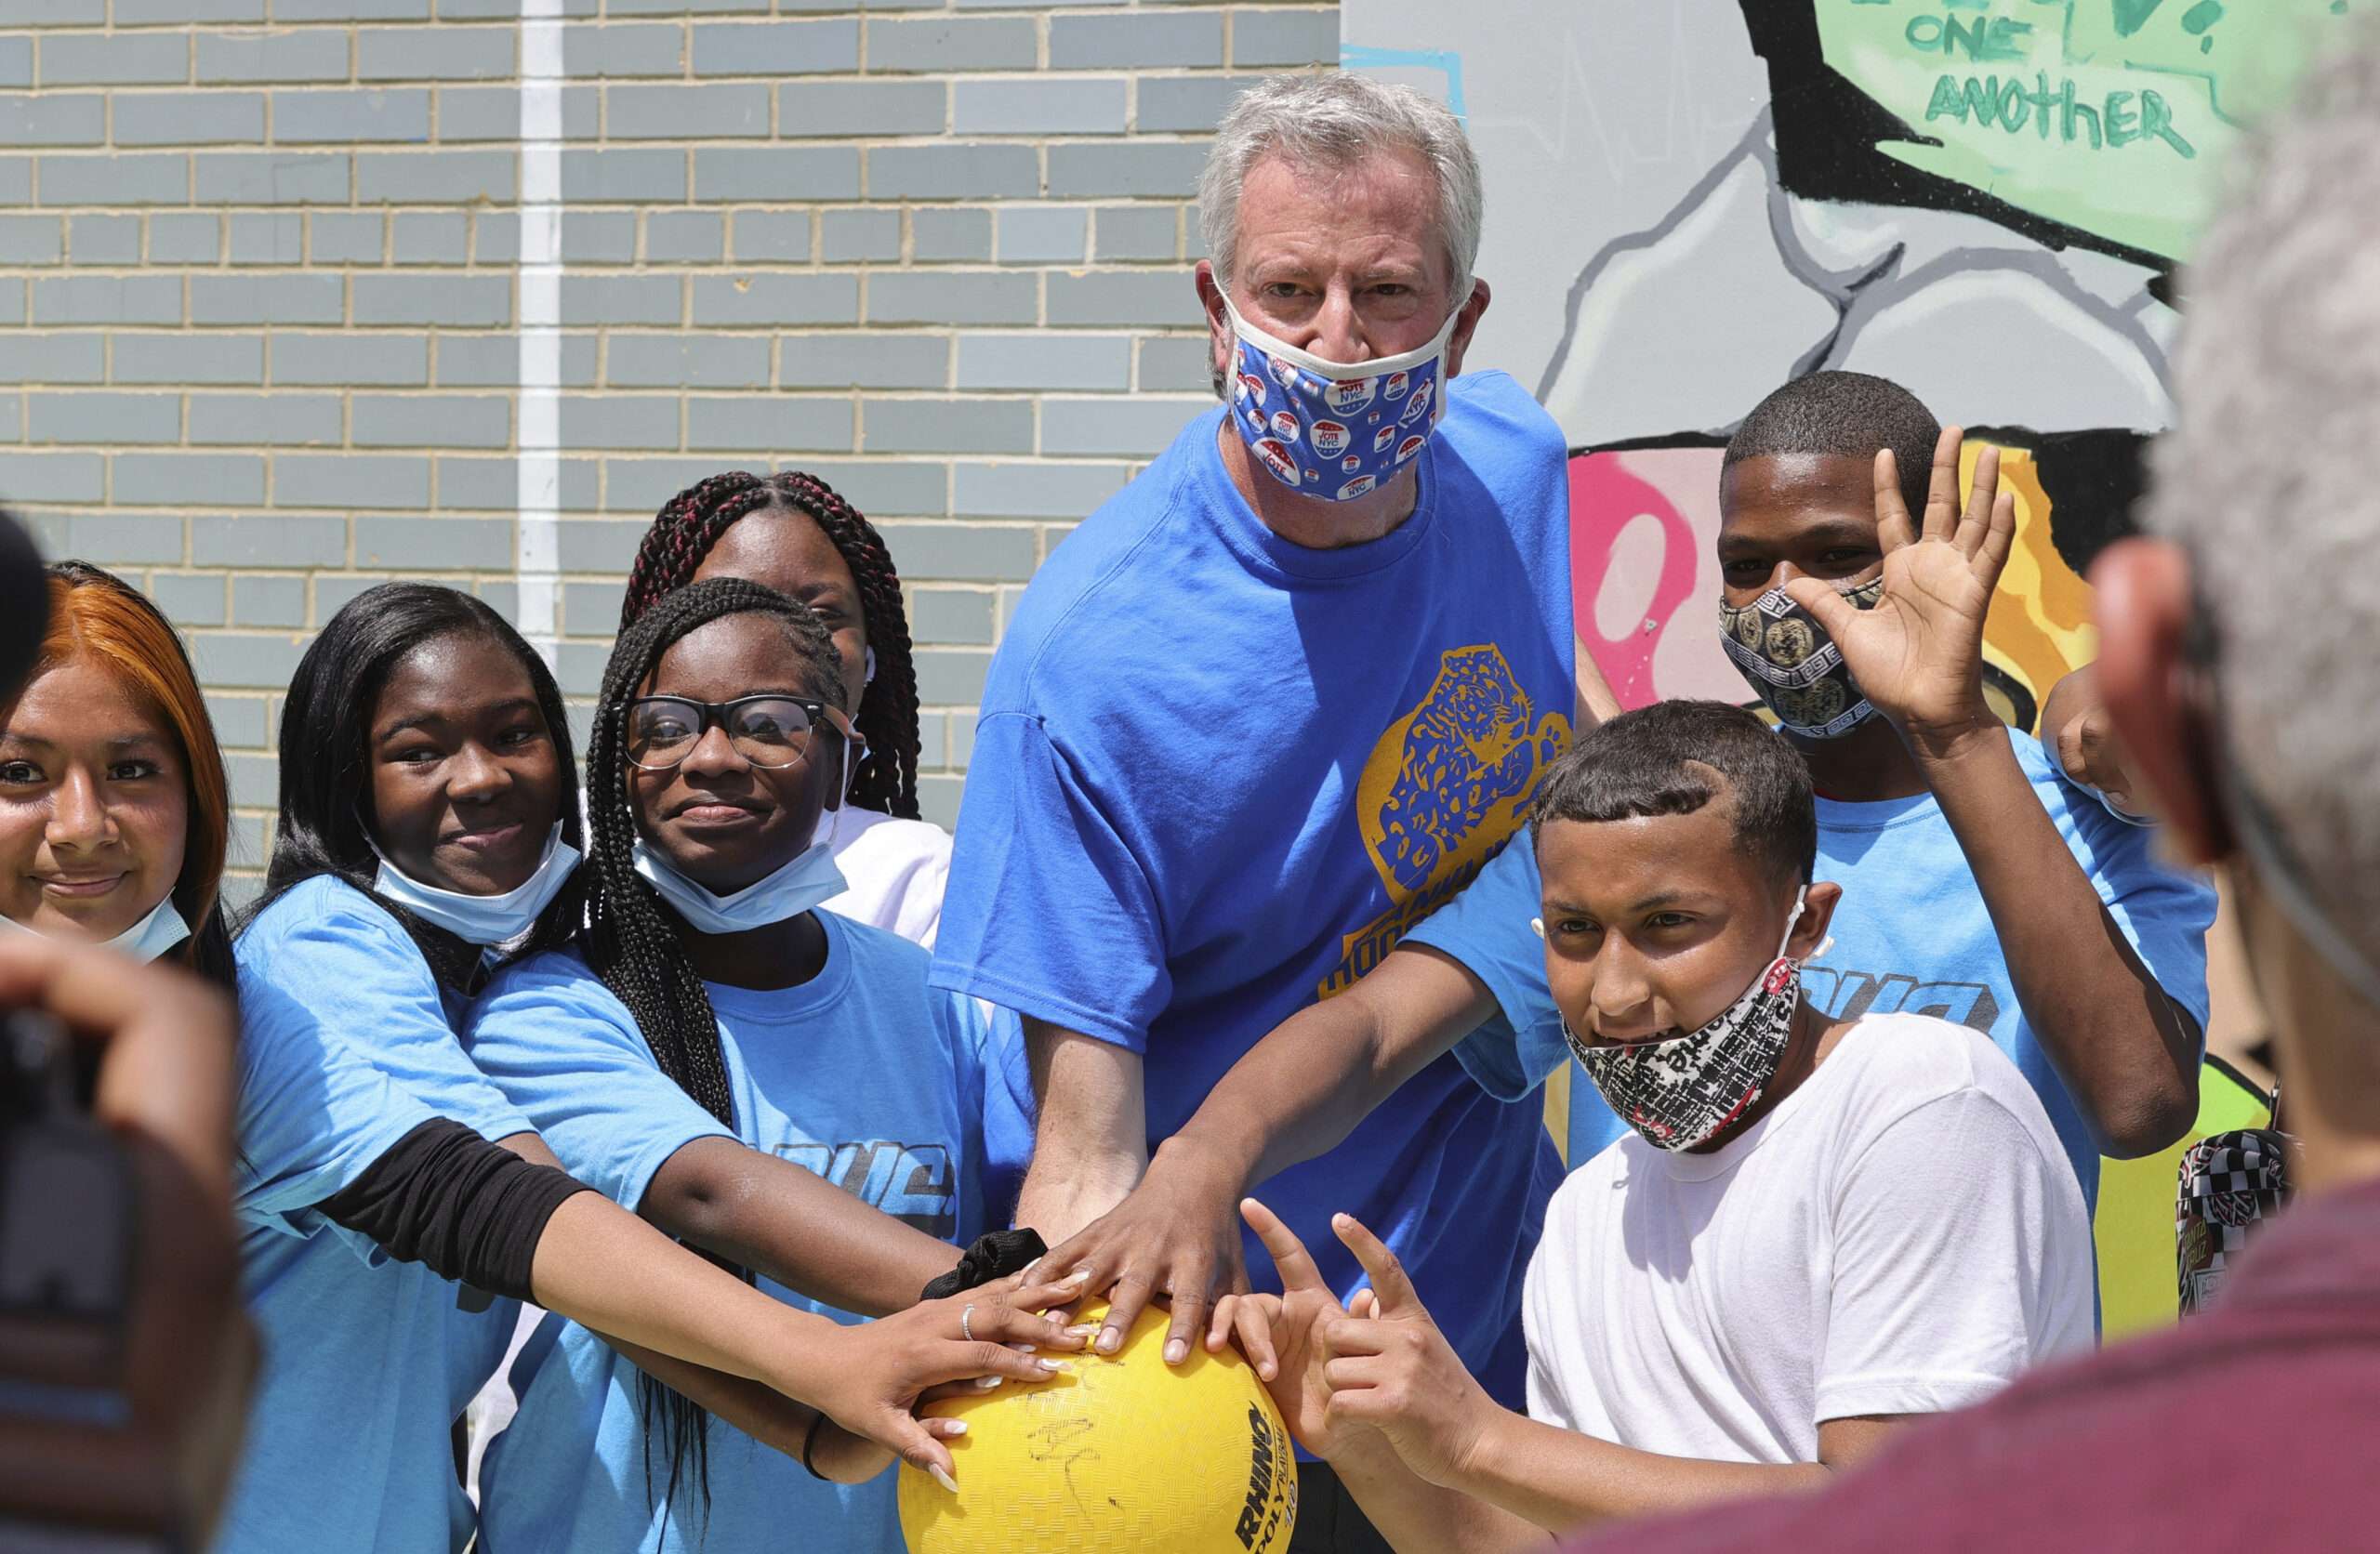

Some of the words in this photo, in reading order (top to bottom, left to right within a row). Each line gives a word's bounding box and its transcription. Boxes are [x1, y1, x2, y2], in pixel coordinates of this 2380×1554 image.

[1905, 12, 2034, 61] ONE
[1340, 382, 1365, 392] VOTE
[1340, 391, 1364, 402] NYC
[1318, 431, 1339, 440] VOTE
[1264, 454, 1288, 474] VOTE
[1235, 1401, 1273, 1551] RHINO
